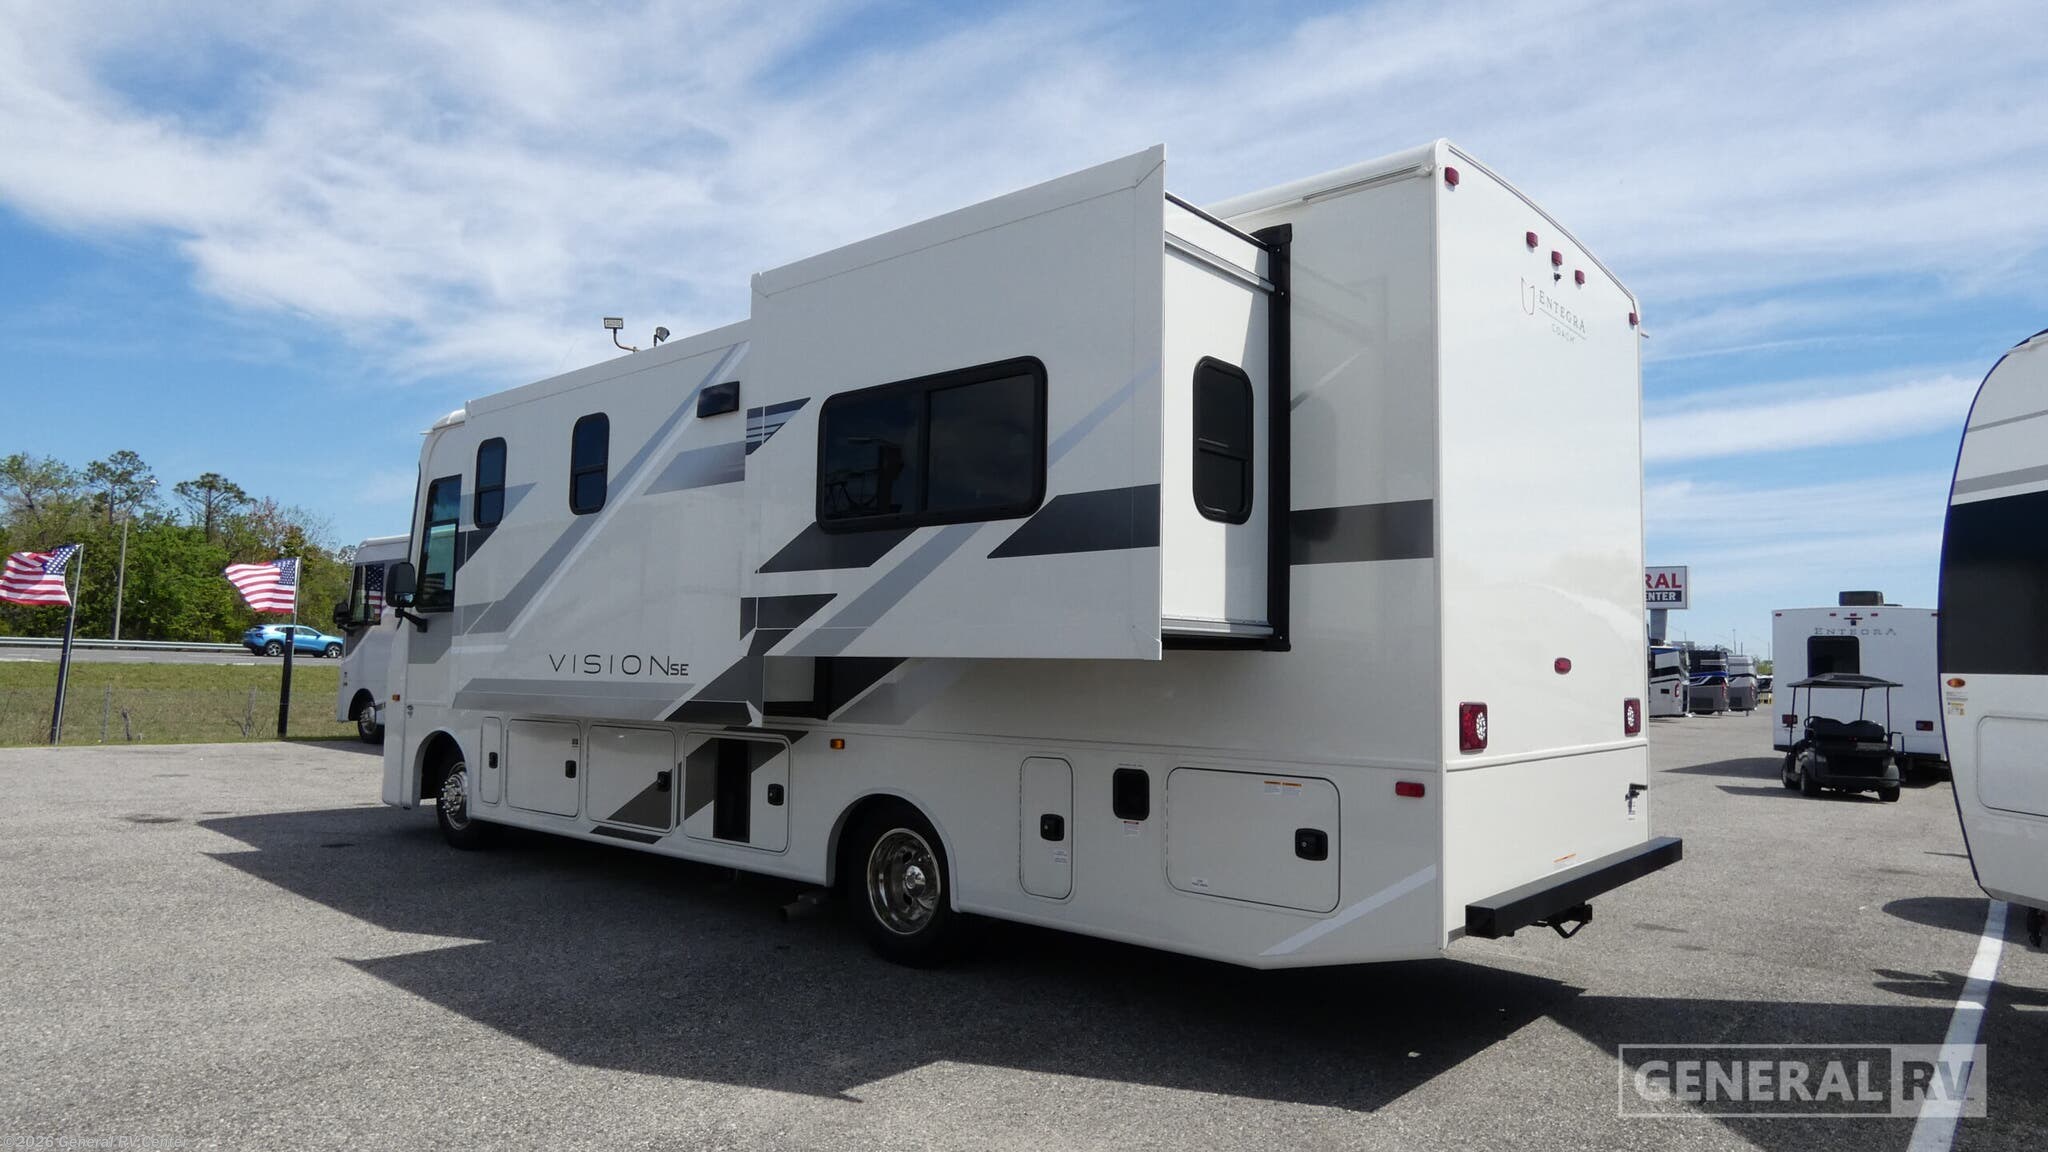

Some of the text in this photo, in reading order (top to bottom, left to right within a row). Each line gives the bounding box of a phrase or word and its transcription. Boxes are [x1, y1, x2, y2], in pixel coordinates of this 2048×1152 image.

[1539, 290, 1586, 334] ENTEGRA
[1645, 573, 1682, 588] RAL
[1647, 591, 1676, 601] NTER
[549, 654, 670, 676] VISION
